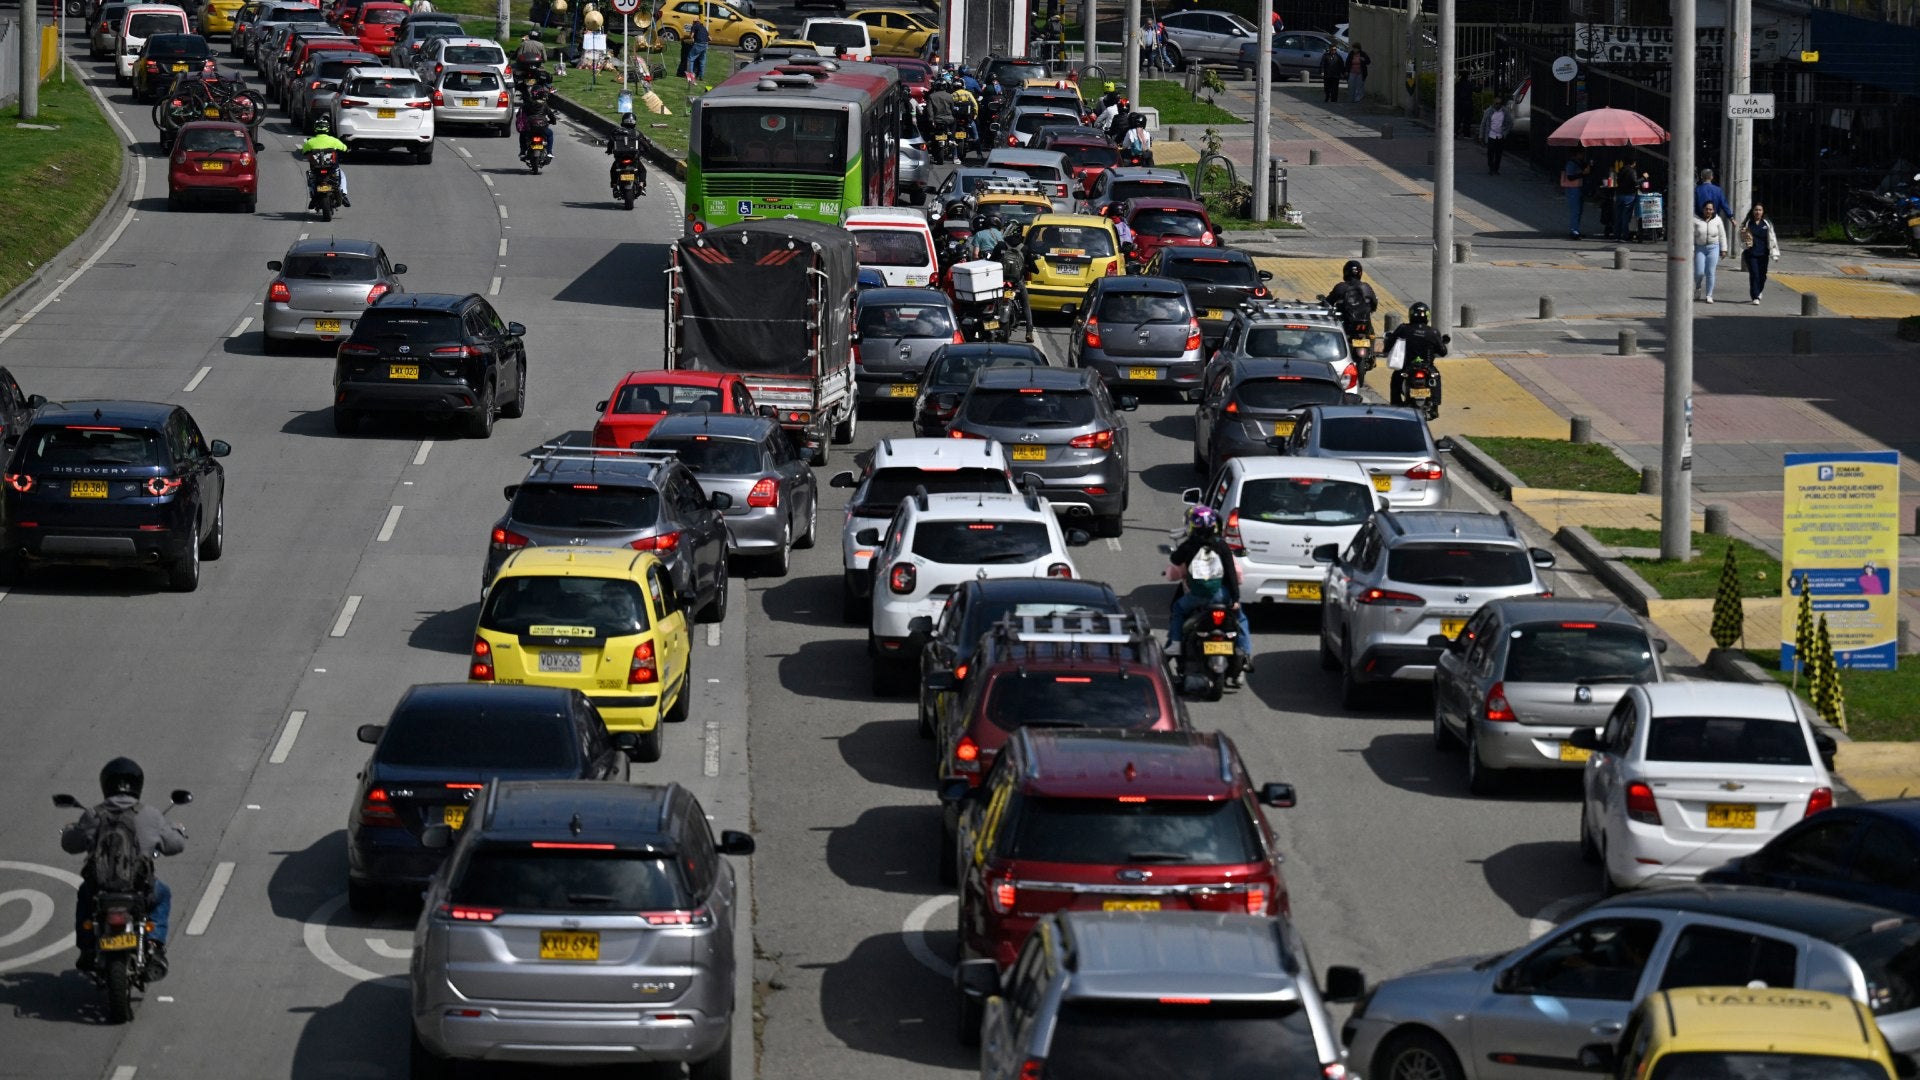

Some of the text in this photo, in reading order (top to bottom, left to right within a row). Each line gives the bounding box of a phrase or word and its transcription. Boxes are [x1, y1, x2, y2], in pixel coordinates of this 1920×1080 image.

[1731, 107, 1771, 115] CERRADA
[819, 202, 839, 213] N624
[52, 466, 129, 475] DISCOVERY
